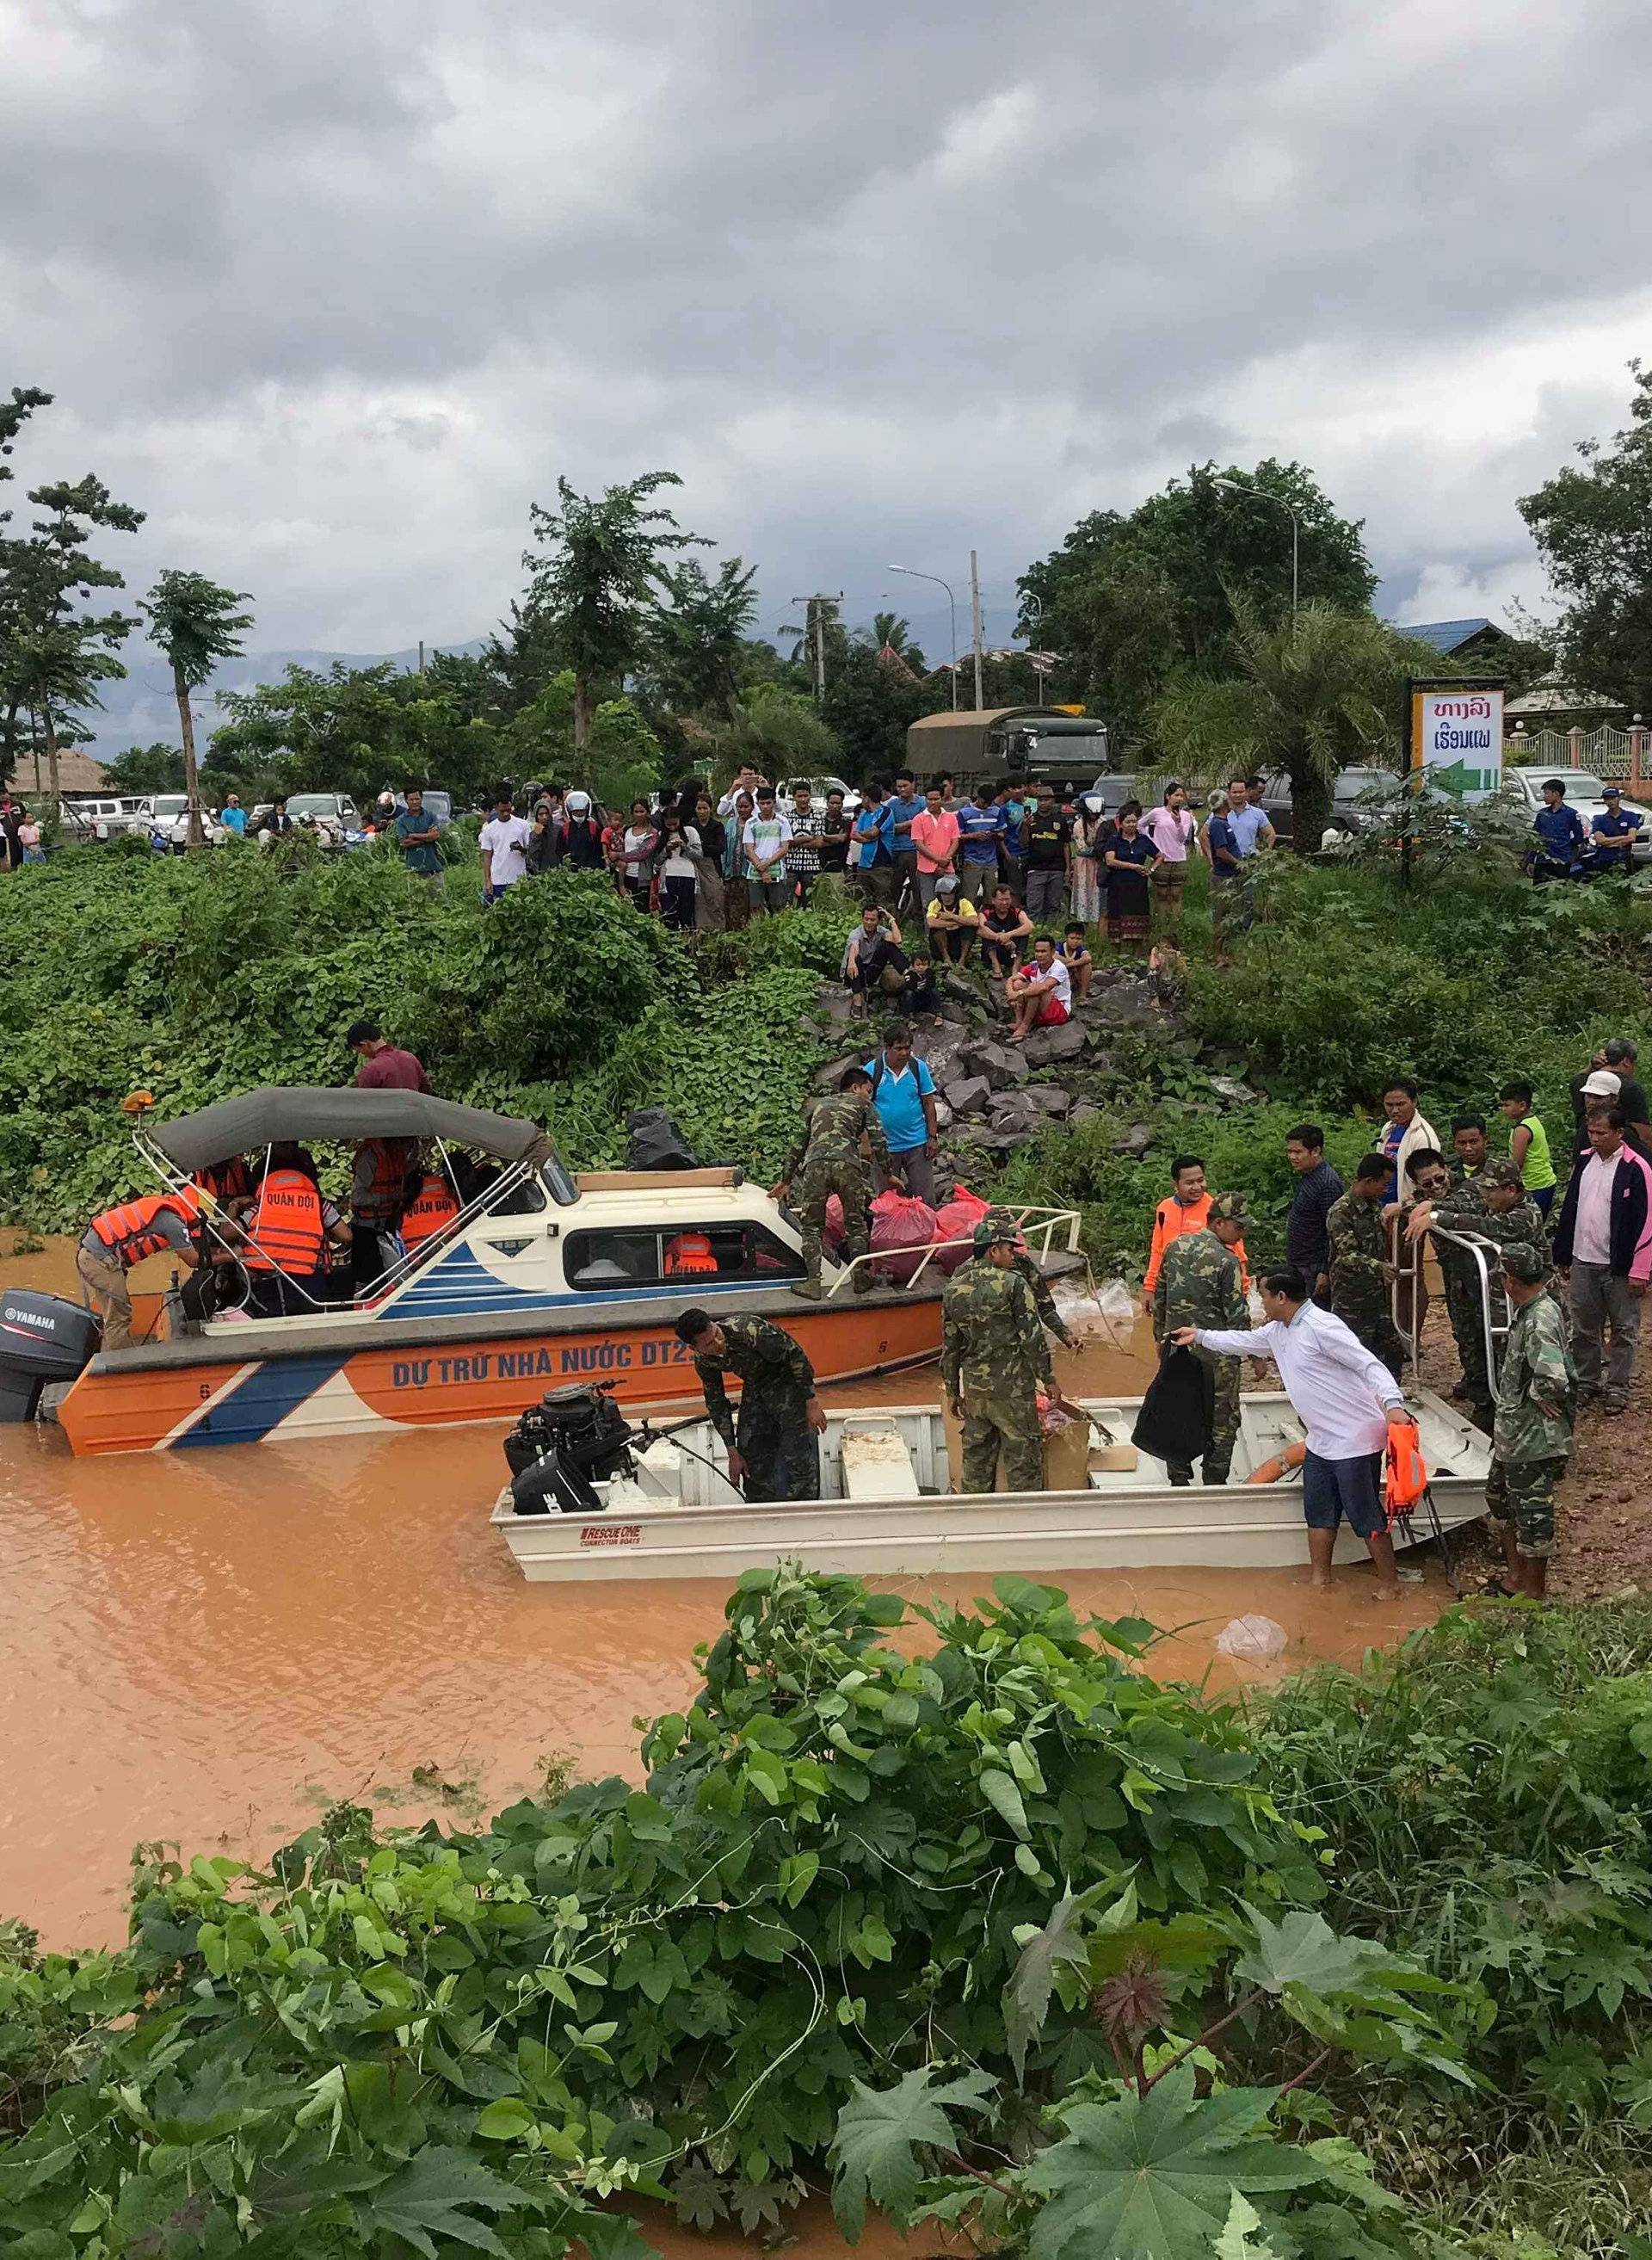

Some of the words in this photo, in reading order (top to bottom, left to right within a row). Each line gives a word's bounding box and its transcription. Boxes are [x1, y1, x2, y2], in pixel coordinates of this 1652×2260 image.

[1434, 697, 1490, 719] ທາງລົງ
[17, 1311, 55, 1330] YAMAHA
[498, 1347, 553, 1378] NHÀ
[562, 1340, 632, 1373] NƯỚC
[641, 1340, 694, 1366] DT2
